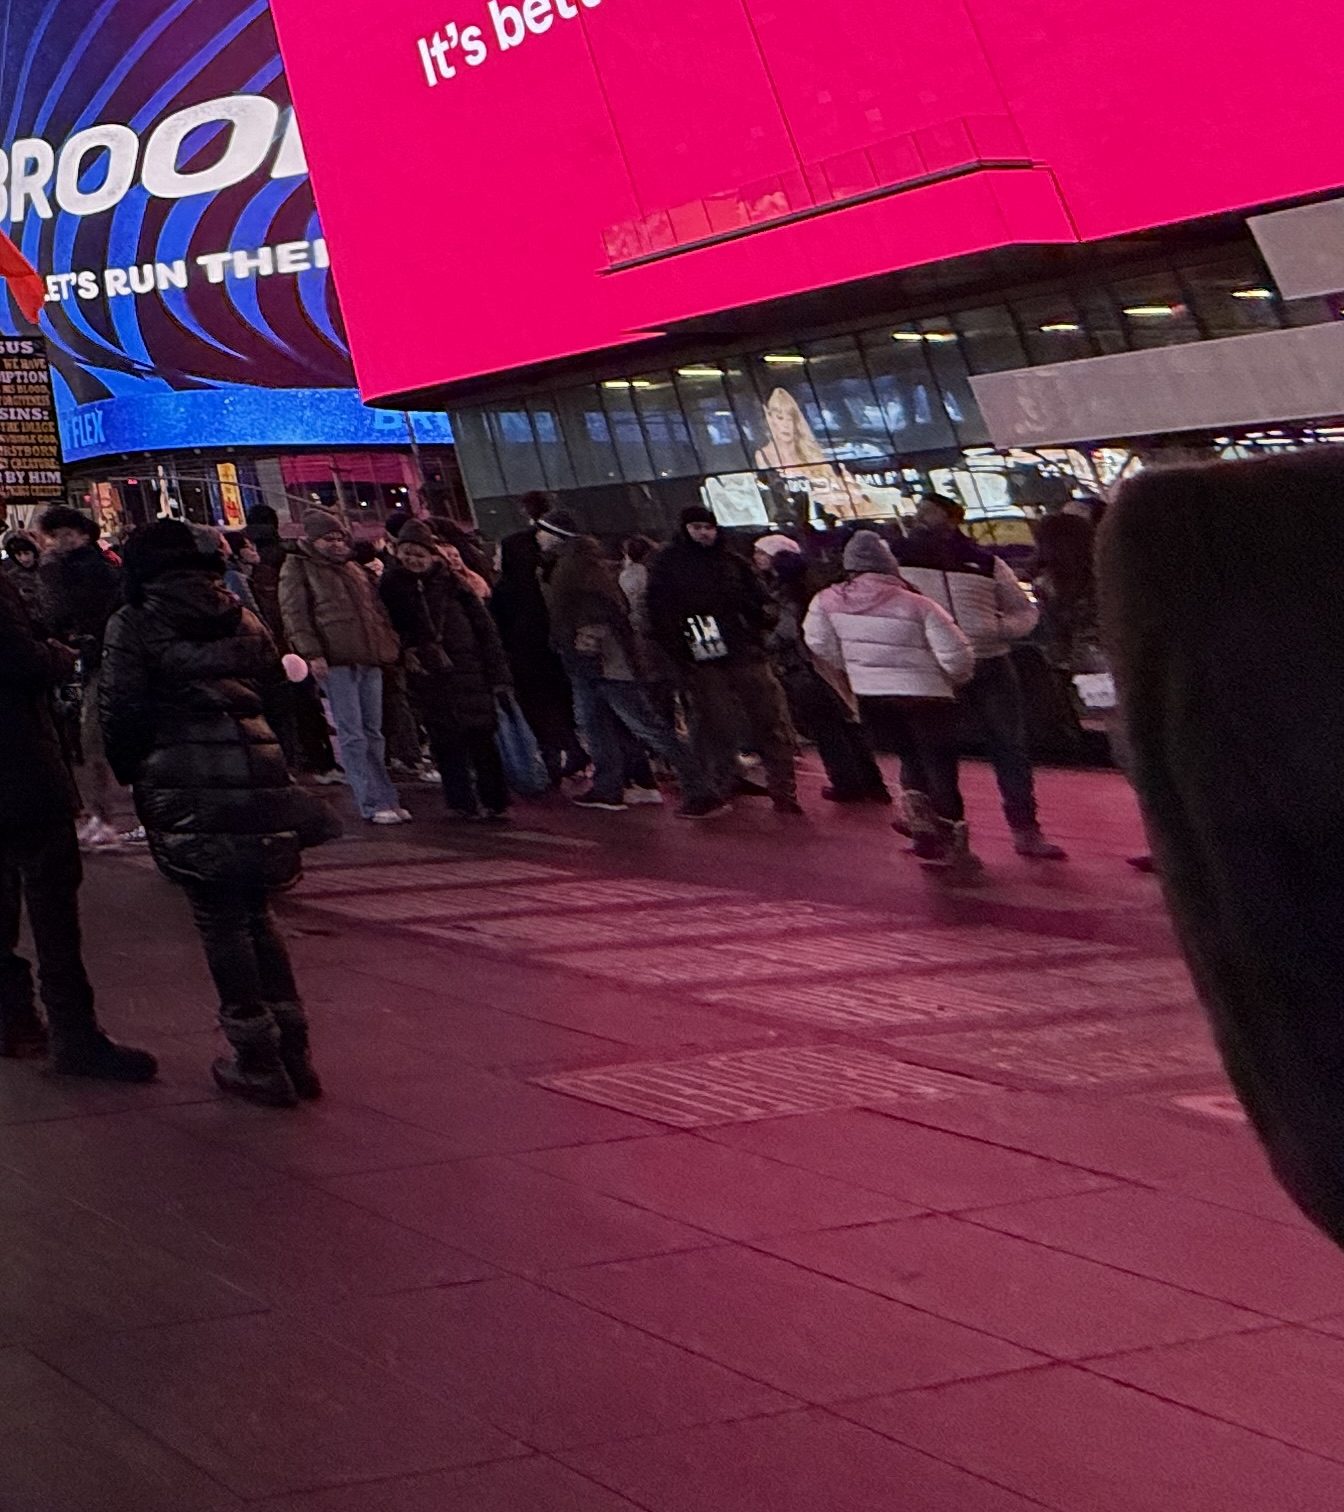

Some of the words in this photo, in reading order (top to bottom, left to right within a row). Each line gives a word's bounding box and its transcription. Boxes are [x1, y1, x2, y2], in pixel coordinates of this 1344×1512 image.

[416, 21, 488, 88] It's
[104, 259, 189, 297] RUN
[5, 471, 25, 484] BY
[29, 471, 62, 484] HIM
